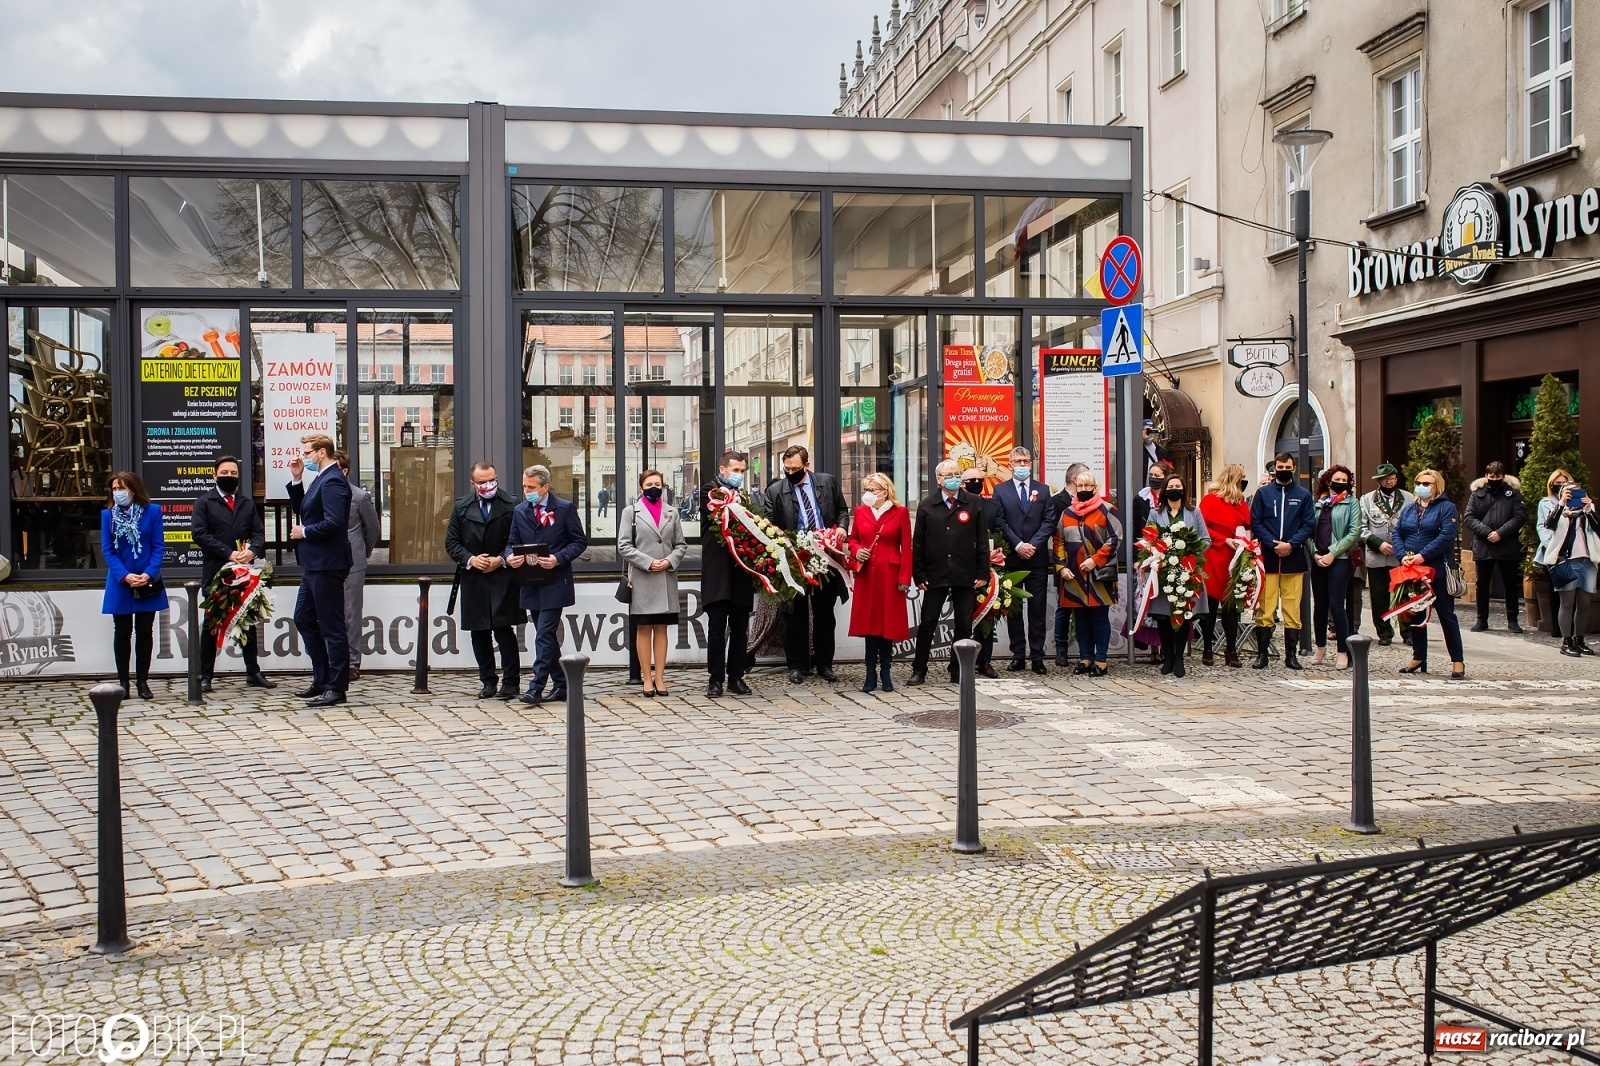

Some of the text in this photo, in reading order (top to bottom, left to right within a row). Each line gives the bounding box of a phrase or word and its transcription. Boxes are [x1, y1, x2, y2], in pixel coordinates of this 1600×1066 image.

[1472, 242, 1496, 264] Rynek
[1347, 236, 1439, 298] Browar
[1245, 348, 1278, 361] BUTIK
[945, 359, 976, 368] Druga pizza
[1052, 356, 1096, 366] LUNCH
[144, 363, 238, 378] CATERING DIETETYCZNY
[267, 358, 333, 376] ZAMÓW
[953, 368, 972, 378] gratis!
[184, 387, 237, 396] BEZ PSZENICY
[270, 383, 331, 391] Z DOWOZEM
[290, 396, 311, 404] LUB
[954, 387, 1005, 405] Promocja
[273, 409, 328, 417] ODBIOREM
[274, 422, 328, 430] W LOKALU
[6, 638, 58, 664] Rynek
